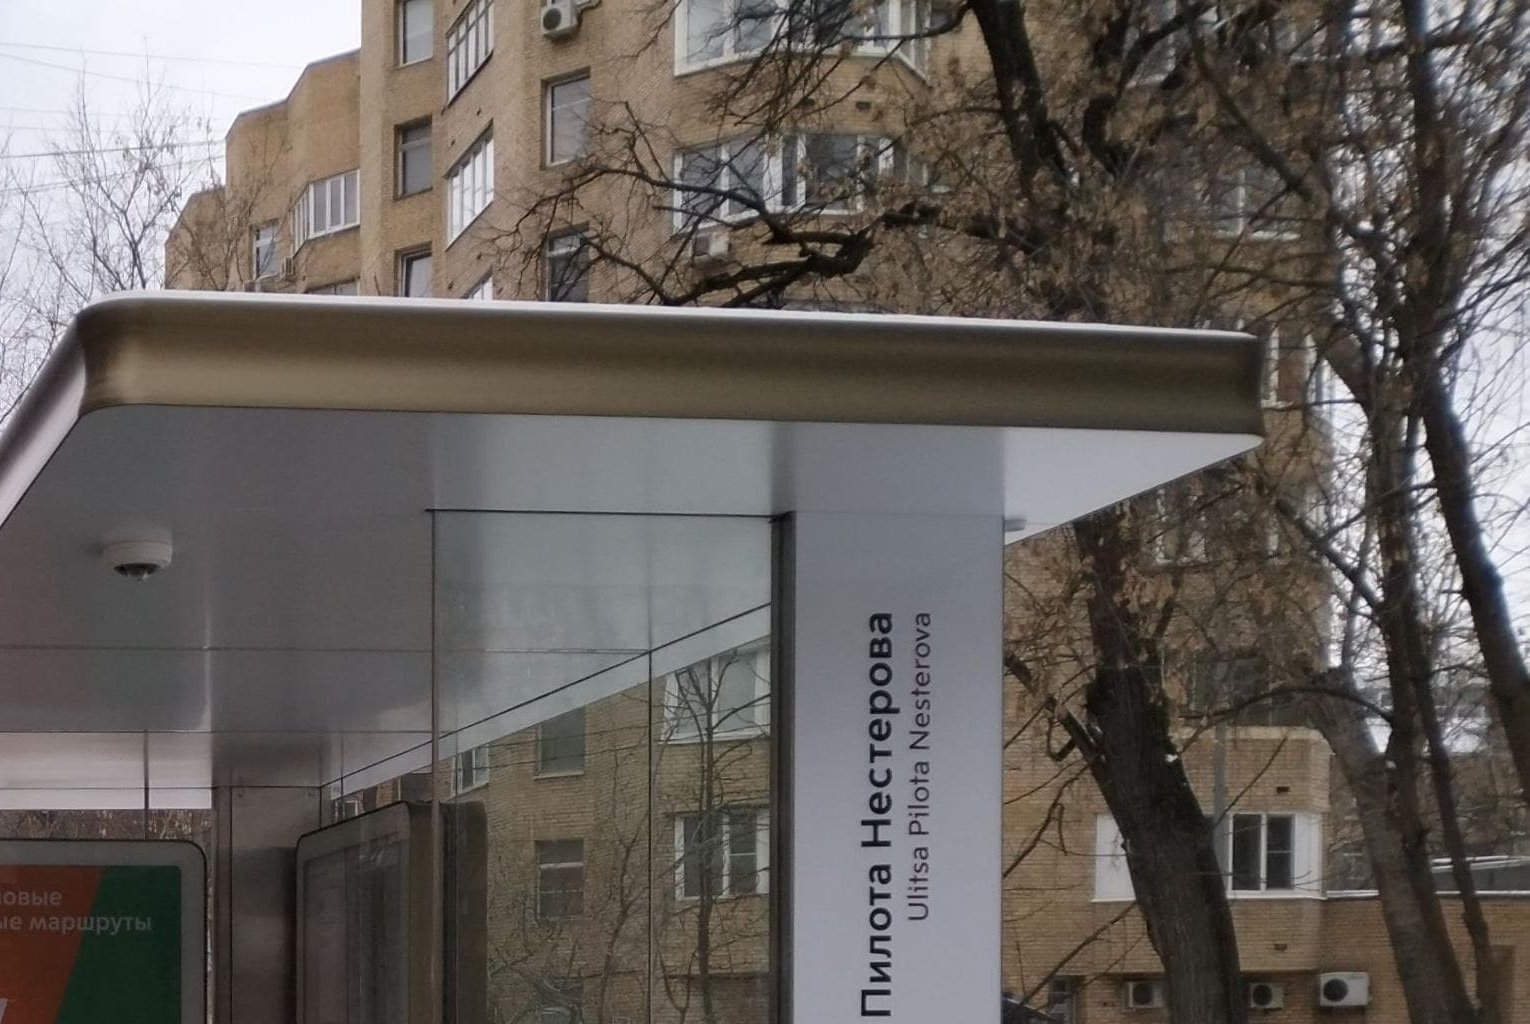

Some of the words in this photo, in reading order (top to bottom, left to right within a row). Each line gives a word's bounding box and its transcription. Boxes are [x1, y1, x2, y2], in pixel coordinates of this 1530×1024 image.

[860, 611, 901, 848] Нестерова
[908, 611, 932, 751] Nesterova
[907, 760, 931, 835] Pilota
[29, 915, 153, 936] маршруты
[906, 845, 930, 921] Ulitsa
[860, 864, 893, 1017] Пилота
